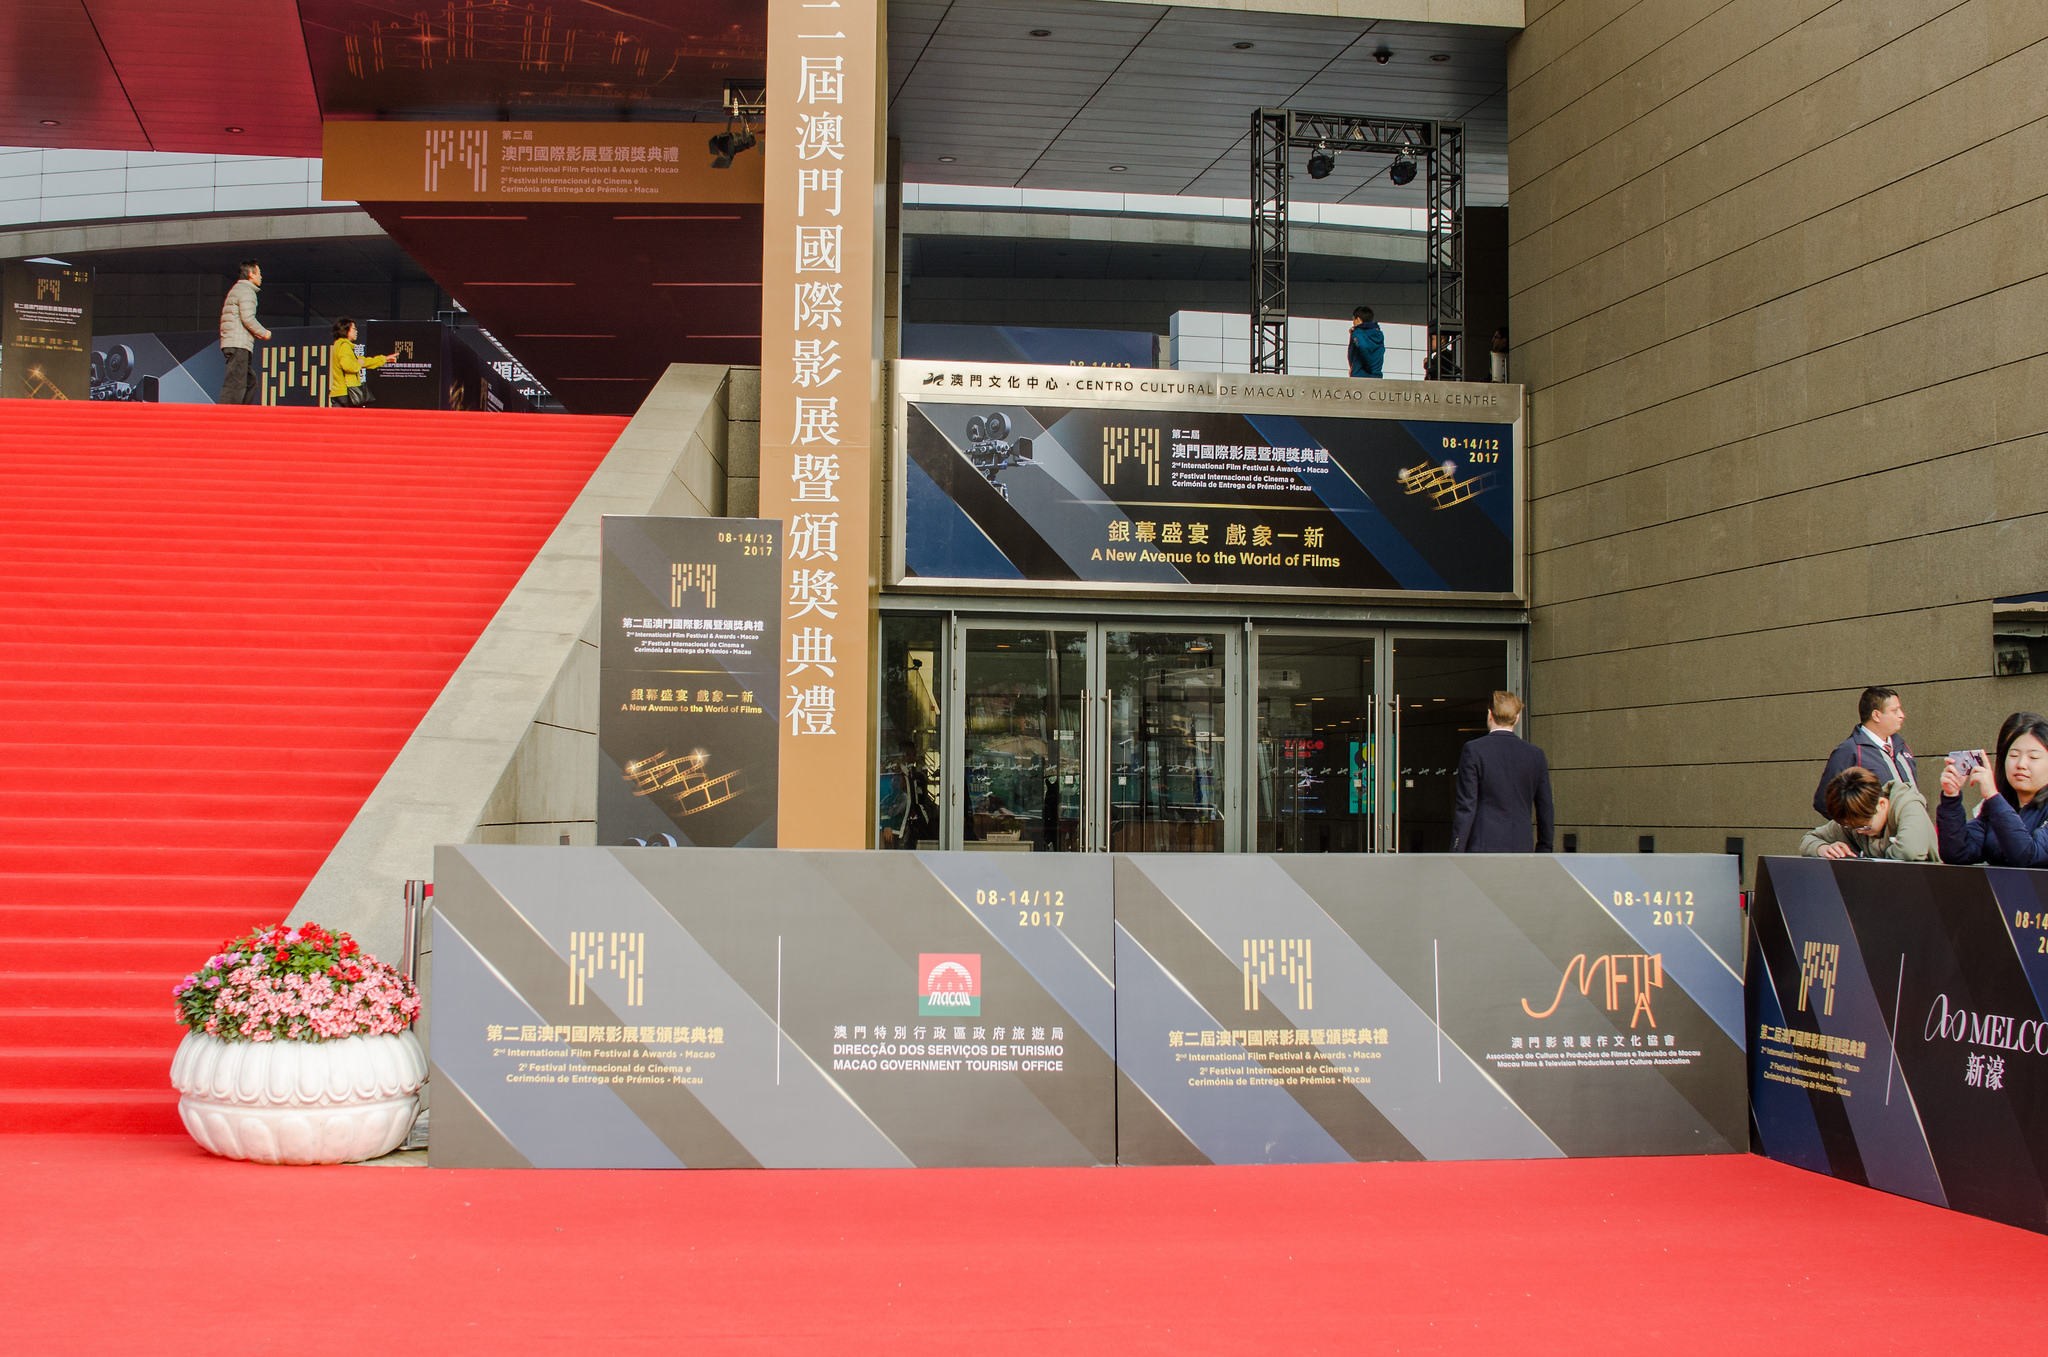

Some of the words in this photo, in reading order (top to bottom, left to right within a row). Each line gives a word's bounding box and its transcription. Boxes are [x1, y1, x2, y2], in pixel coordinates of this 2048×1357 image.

[502, 130, 533, 140] 第二屆
[502, 146, 679, 162] 澳門國際影展暨頒獎典禮
[540, 177, 589, 185] Internacional
[591, 177, 602, 185] de
[554, 186, 582, 194] Entrega
[950, 373, 1058, 390] 澳門文化中心
[1076, 379, 1134, 392] CENTRO
[1140, 382, 1214, 395] CULTURAL
[1219, 385, 1238, 396] DE
[1244, 386, 1295, 398] MACAU
[1311, 389, 1362, 401] MACAO
[1368, 391, 1439, 404] CULTURAL
[1445, 394, 1497, 406] CENTRE
[1172, 429, 1199, 440] 第二屆
[1443, 436, 1499, 449] 08-14/12
[1172, 443, 1328, 463] 澳門國際影展暨頒獎典禮
[1469, 452, 1498, 463] 2017
[1181, 462, 1224, 470] International
[1207, 473, 1250, 481] Internacional
[1218, 482, 1244, 490] Entrega
[718, 532, 772, 543] 08-14/12
[1108, 520, 1209, 544] 銀幕盛宴
[1225, 523, 1324, 548] 戲象一新
[744, 546, 772, 555] 2017
[1091, 549, 1102, 560] A
[1106, 550, 1136, 561] New
[1139, 550, 1192, 563] Avenue
[1196, 552, 1210, 563] to
[1214, 552, 1236, 564] the
[1240, 553, 1280, 565] World
[1285, 554, 1299, 566] of
[1303, 555, 1340, 567] Films
[630, 688, 688, 701] 銀幕盛宴
[696, 689, 753, 703] 戲象一新
[648, 704, 678, 712] Avenue
[690, 704, 703, 712] the
[740, 705, 762, 713] Films
[976, 889, 1064, 906] 08-14/12
[1614, 891, 1694, 906] 08-14/12
[1019, 911, 1064, 926] 2017
[1653, 911, 1695, 925] 2017
[486, 1024, 724, 1044] 第二屆澳門國際影展暨頒獎典禮
[834, 1025, 1064, 1041] 澳門特別行政區政府旅遊局
[1168, 1028, 1388, 1047] 第二屆澳門國際影展暨頒獎典禮
[1511, 1034, 1675, 1048] 澳門影視製作文化協會
[507, 1048, 568, 1057] International
[570, 1048, 591, 1057] Film
[594, 1049, 631, 1058] Festival
[633, 1049, 639, 1058] &
[641, 1050, 677, 1058] Awards
[685, 1050, 715, 1058] Macao
[834, 1042, 896, 1057] DIRECÇÃO
[900, 1045, 925, 1055] DOS
[928, 1045, 987, 1058] SERVIÇOS
[991, 1045, 1007, 1056] DE
[1010, 1045, 1063, 1056] TURISMO
[1188, 1052, 1245, 1061] International
[1247, 1052, 1266, 1060] Film
[1269, 1052, 1302, 1060] Festival
[1305, 1052, 1311, 1060] &
[1313, 1051, 1346, 1060] Awards
[1353, 1051, 1381, 1059] Macao
[1486, 1052, 1523, 1060] Associação
[1566, 1051, 1599, 1059] Produções
[529, 1063, 566, 1072] Festival
[568, 1063, 630, 1073] Internacional
[633, 1064, 645, 1073] de
[647, 1064, 683, 1073] Cinema
[834, 1059, 877, 1070] MACAO
[880, 1059, 961, 1071] GOVERNMENT
[965, 1060, 1018, 1071] TOURISM
[1021, 1060, 1063, 1071] OFFICE
[1209, 1066, 1244, 1075] Festival
[1246, 1066, 1303, 1074] Internacional
[1305, 1065, 1317, 1074] de
[1319, 1065, 1351, 1073] Cinema
[1964, 1051, 2005, 1090] 新濠
[506, 1073, 554, 1083] Cerimónia
[557, 1074, 569, 1083] de
[572, 1074, 609, 1085] Entrega
[611, 1075, 624, 1083] de
[627, 1075, 664, 1084] Prémios
[672, 1076, 703, 1084] Macau
[1188, 1077, 1234, 1086] Cerimónia
[1236, 1077, 1247, 1085] de
[1249, 1076, 1284, 1087] Entrega
[1286, 1076, 1298, 1085] de
[1300, 1075, 1335, 1084] Prémios
[1342, 1075, 1371, 1083] Macau
